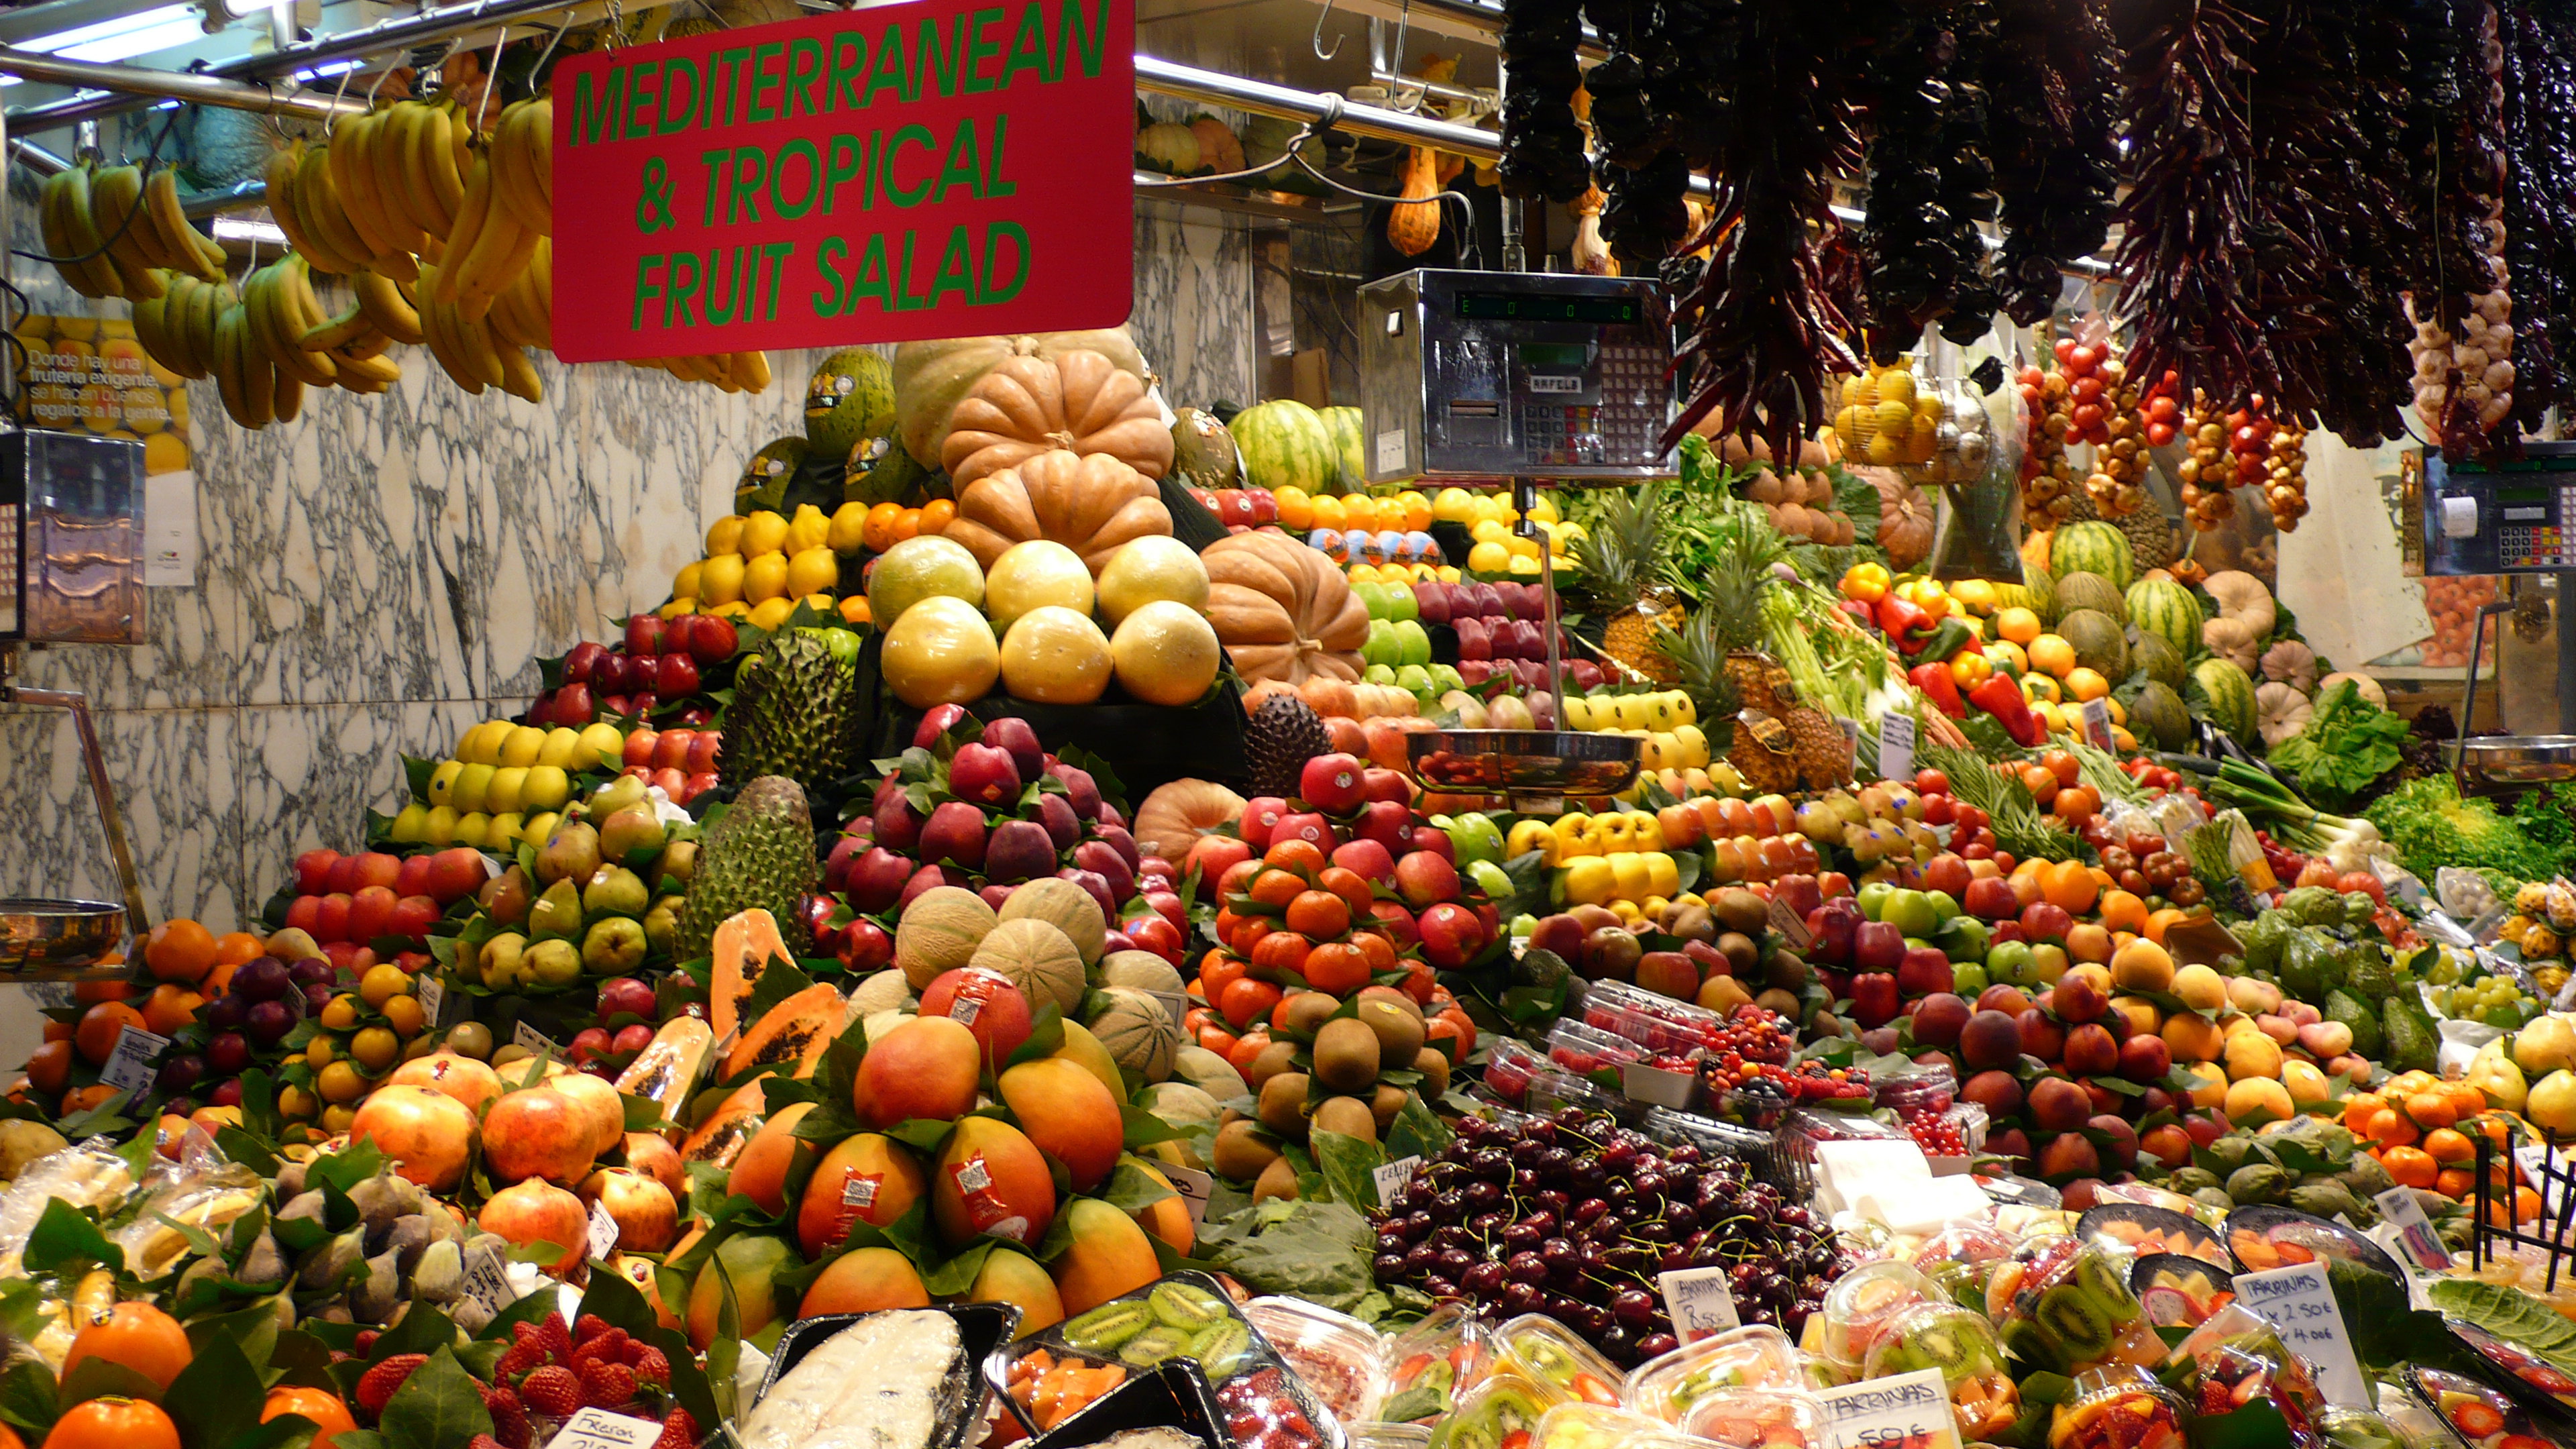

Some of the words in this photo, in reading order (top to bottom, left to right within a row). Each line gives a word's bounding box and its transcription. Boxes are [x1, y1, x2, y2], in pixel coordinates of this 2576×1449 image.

[569, 0, 1112, 147] MEDITERRANEAN
[636, 156, 677, 235] &
[702, 113, 1018, 227] TROPICAL
[631, 241, 796, 331] FRUIT
[812, 220, 1032, 319] SALAD
[30, 350, 78, 367] Donde
[83, 353, 110, 372] hay
[113, 357, 141, 370] una
[30, 386, 48, 400] se
[53, 385, 98, 402] hacen
[101, 387, 156, 403] buenos
[31, 402, 91, 421] regalos
[94, 407, 105, 419] a
[108, 403, 122, 419] la
[2241, 1274, 2321, 1298] TARRINAS
[1817, 1383, 1937, 1415] TARRINAS
